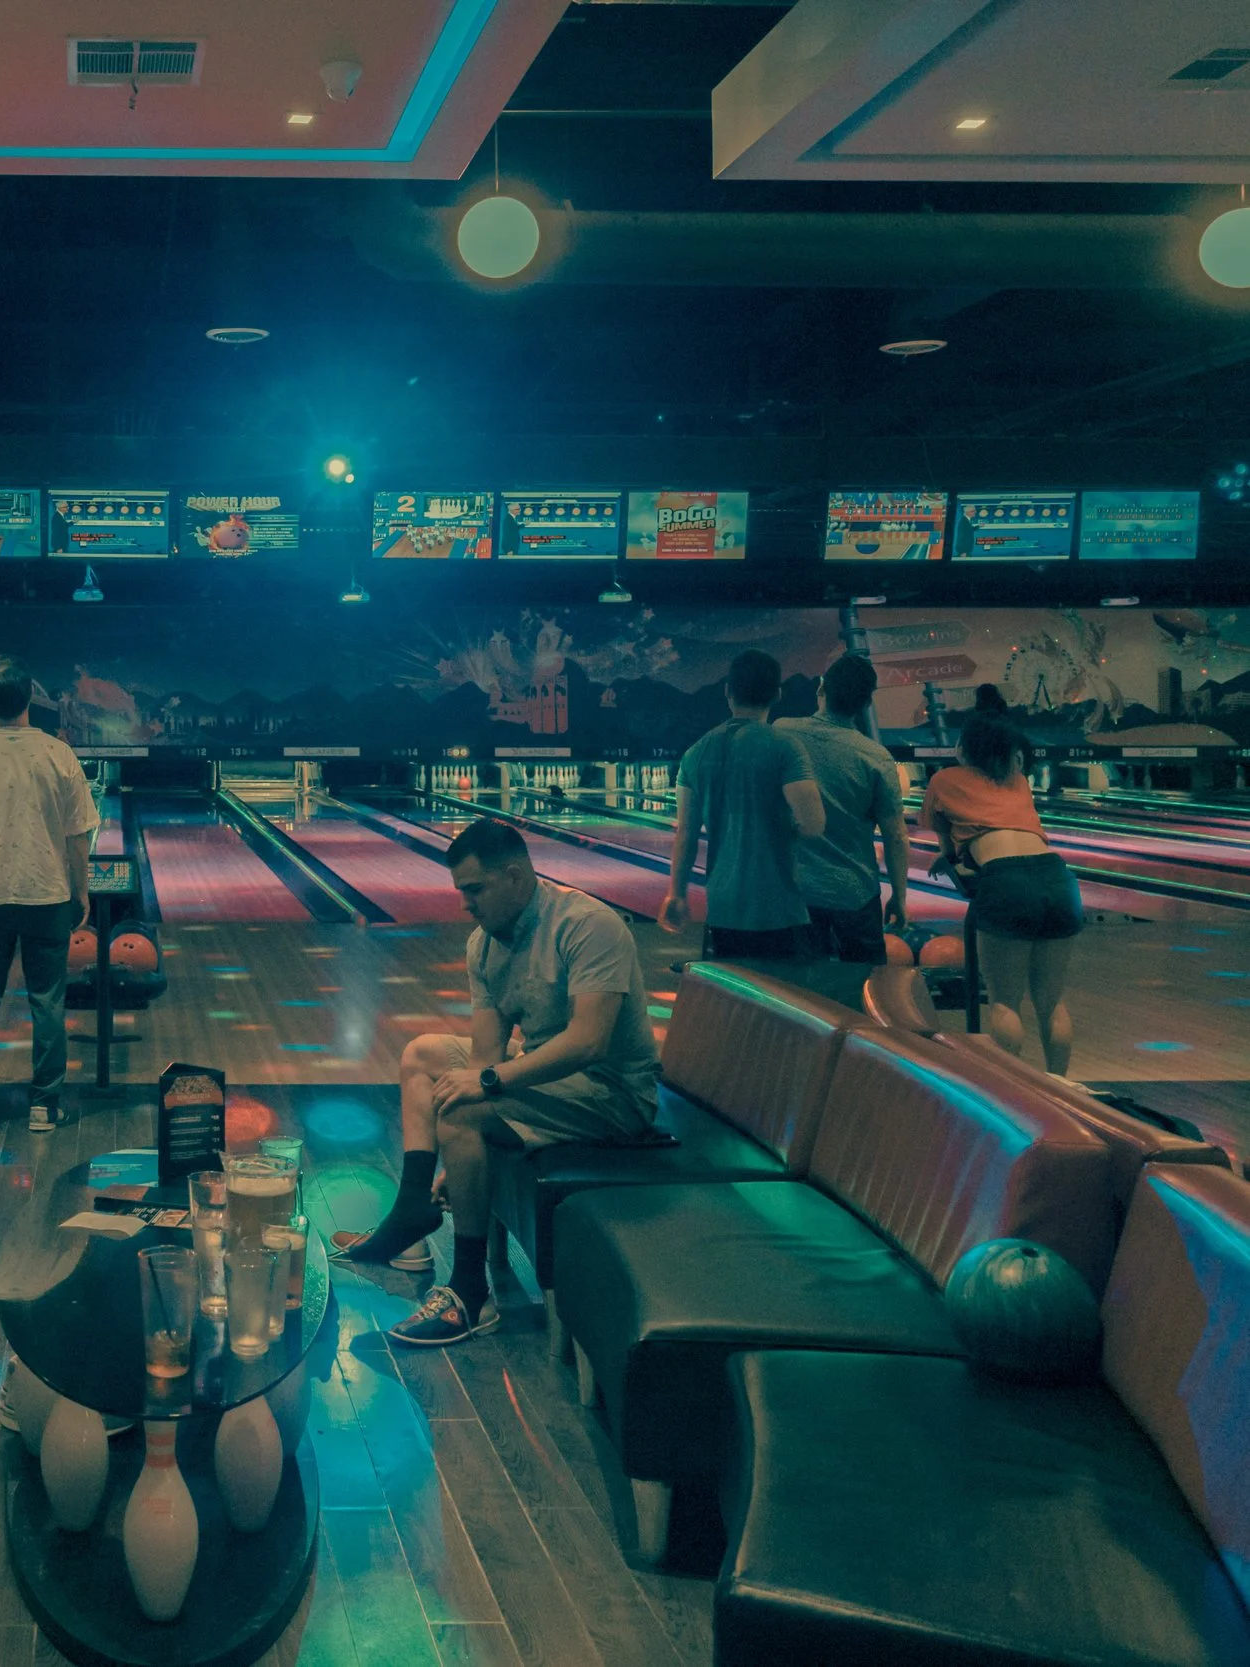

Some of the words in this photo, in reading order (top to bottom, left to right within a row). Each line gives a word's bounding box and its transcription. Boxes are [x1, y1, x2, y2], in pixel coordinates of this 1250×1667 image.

[187, 496, 240, 511] POWER
[397, 495, 416, 512] 2
[878, 628, 961, 646] Bowling
[885, 662, 963, 681] Arcade
[196, 747, 207, 756] 12
[230, 747, 241, 756] 13
[407, 748, 418, 757] 14
[652, 748, 664, 757] 17
[1034, 748, 1047, 757] 20
[1068, 748, 1080, 757] 21
